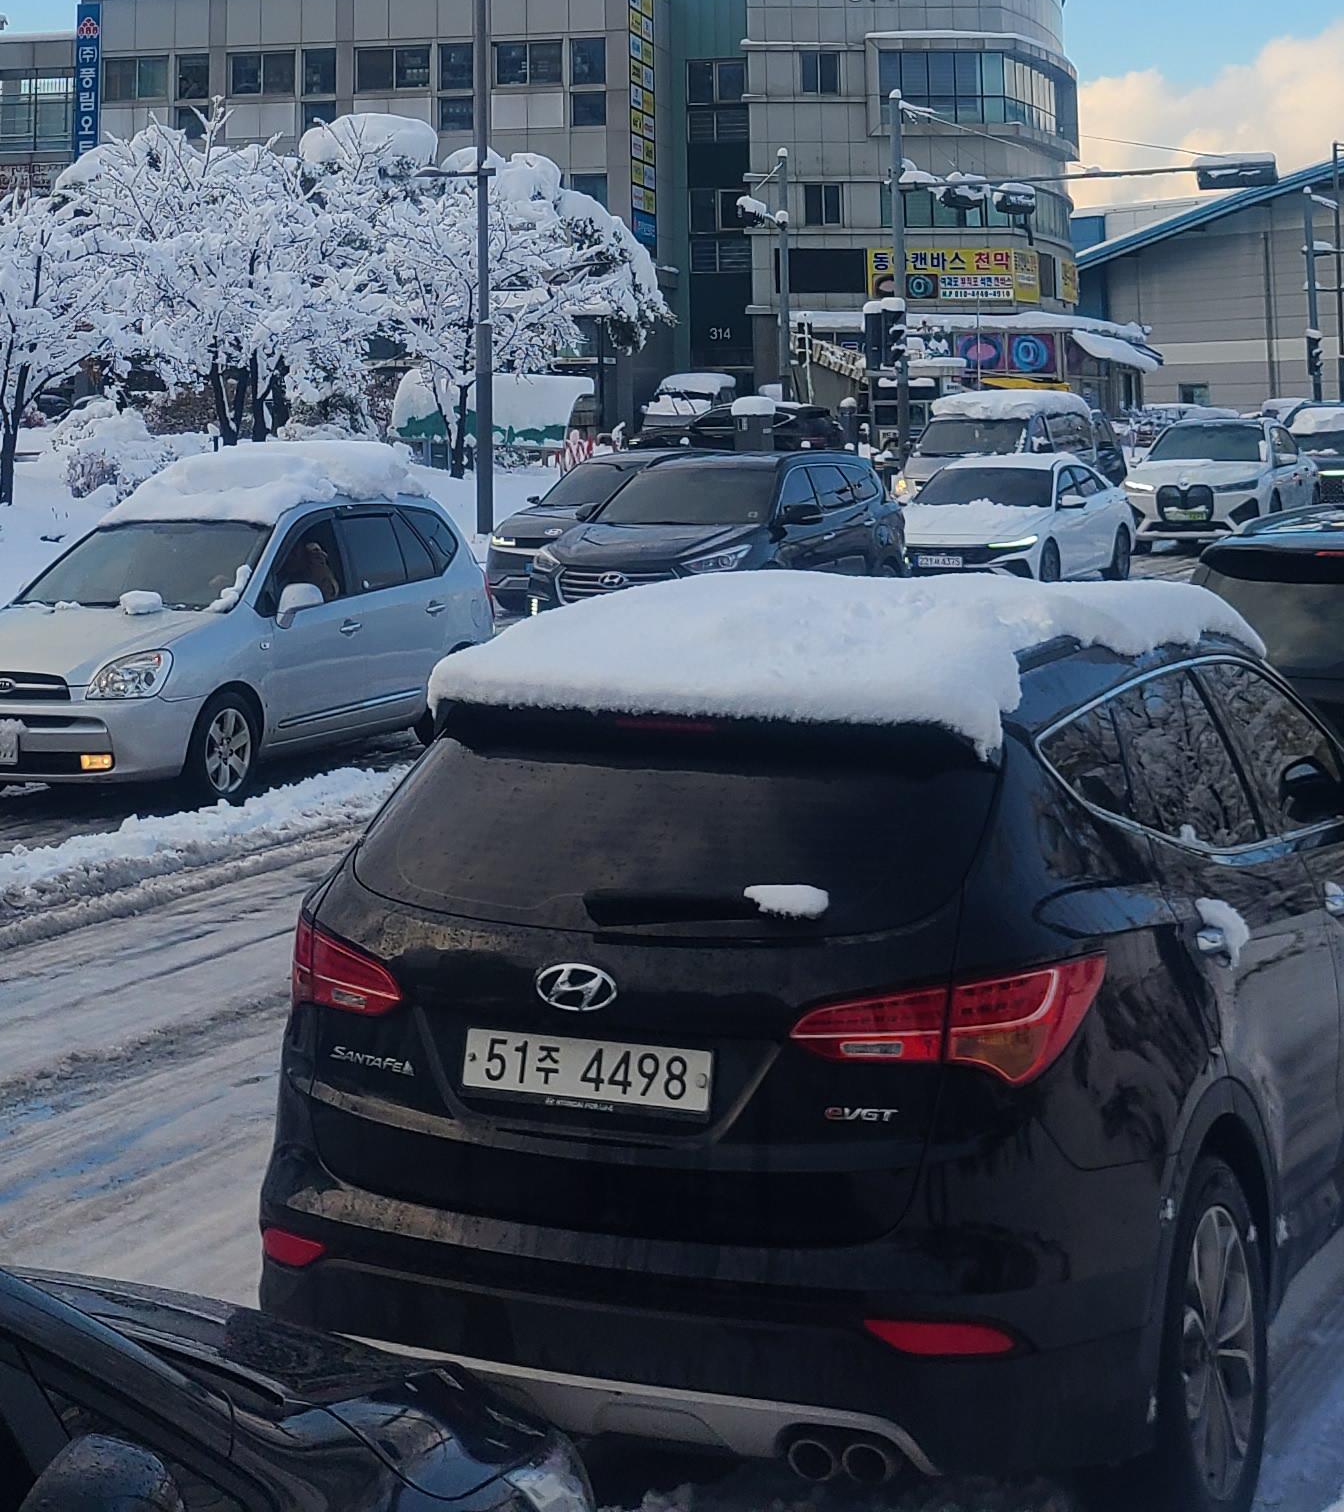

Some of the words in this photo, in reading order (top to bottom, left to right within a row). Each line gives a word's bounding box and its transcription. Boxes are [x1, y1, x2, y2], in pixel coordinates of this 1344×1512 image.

[974, 251, 1011, 270] 천막
[710, 327, 732, 340] 314
[485, 1037, 560, 1085] 51주
[580, 1047, 688, 1101] 4498
